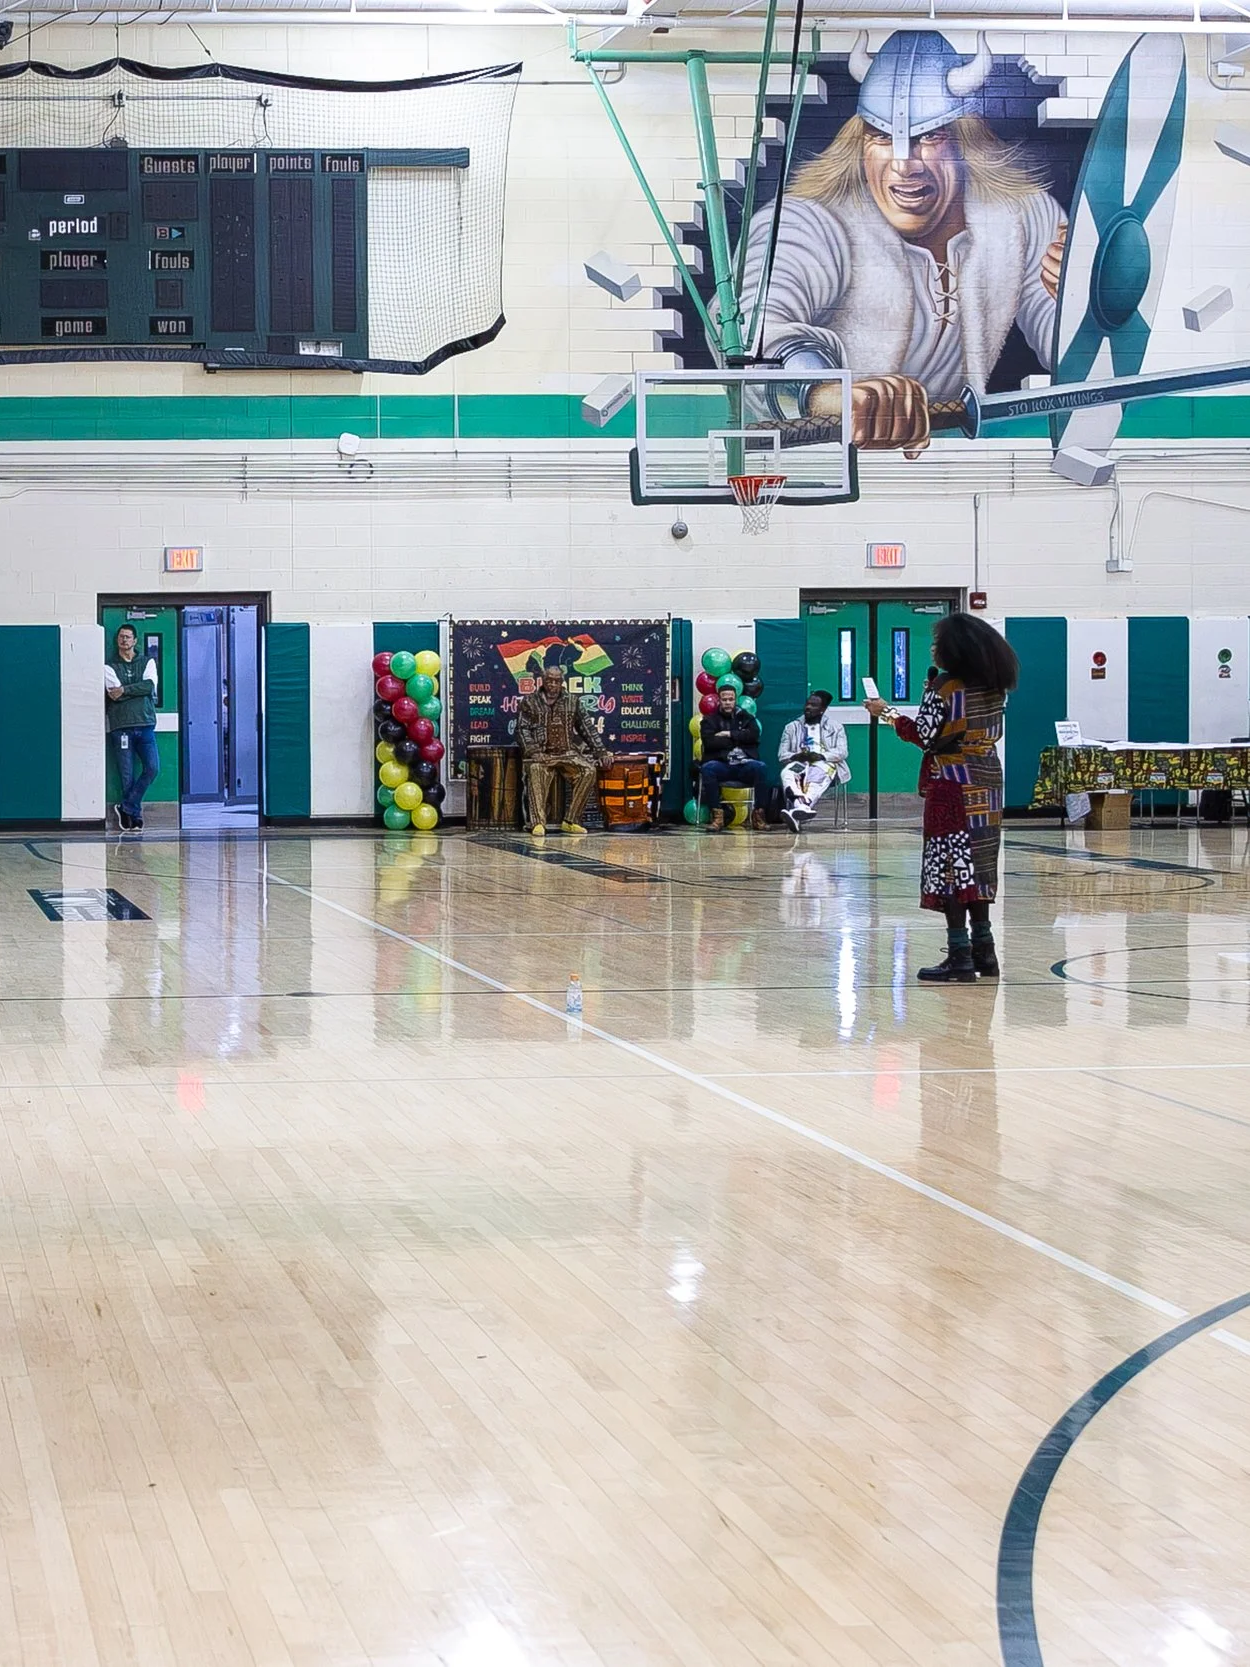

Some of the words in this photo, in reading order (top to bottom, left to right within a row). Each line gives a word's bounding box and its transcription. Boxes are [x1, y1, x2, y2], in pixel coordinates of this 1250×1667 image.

[143, 156, 196, 174] Guests
[209, 154, 251, 173] player
[269, 155, 312, 173] points
[325, 155, 360, 173] fouls
[49, 216, 98, 236] period
[49, 251, 98, 271] player
[155, 252, 190, 269] fouls
[55, 320, 93, 336] game
[157, 320, 186, 333] won
[1031, 398, 1056, 412] ROX
[1058, 391, 1104, 408] VIKINGS
[173, 548, 199, 569] EXIT
[469, 683, 491, 692] BUILD
[518, 676, 602, 694] BCK
[621, 683, 644, 691] THINK
[469, 695, 492, 704] SPEAK
[469, 707, 495, 716] DREAM
[621, 706, 652, 715] EDUCATE
[470, 721, 489, 729] LEAD
[621, 720, 661, 729] CHALLENGE
[469, 734, 491, 743] FIGHT
